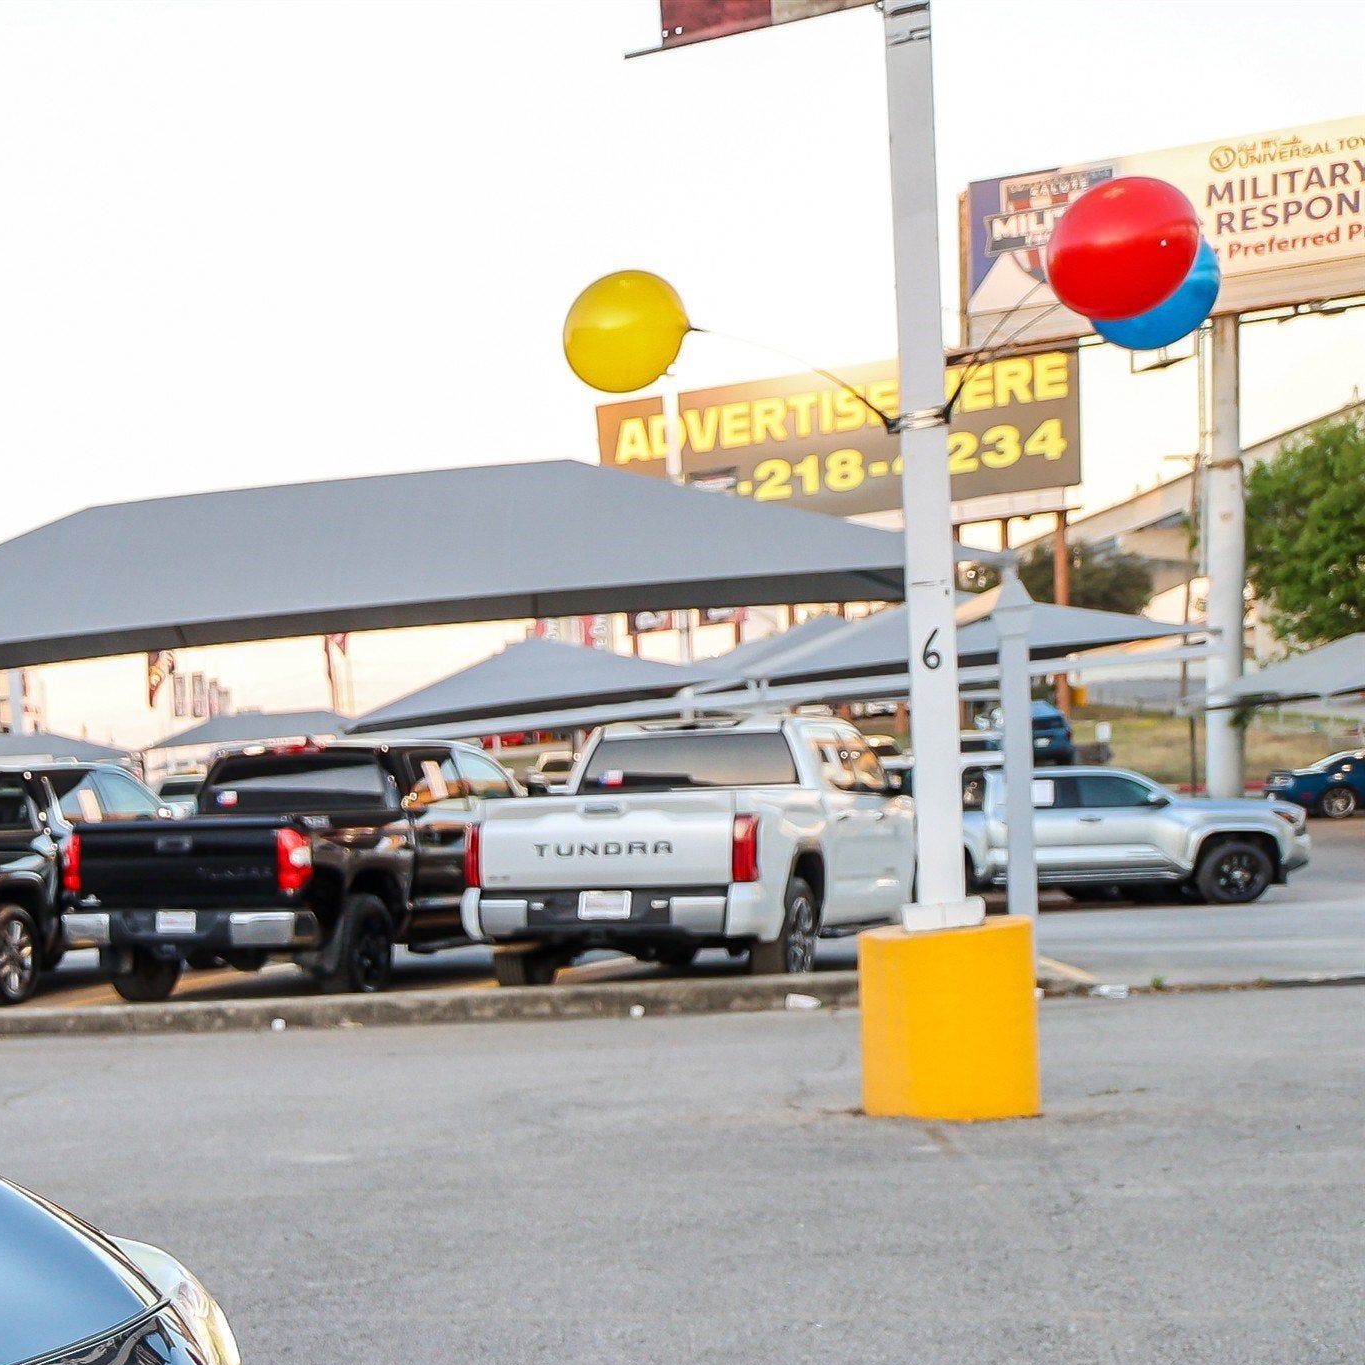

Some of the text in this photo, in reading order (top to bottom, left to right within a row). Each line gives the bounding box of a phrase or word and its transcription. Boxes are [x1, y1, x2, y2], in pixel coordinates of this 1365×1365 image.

[1238, 142, 1334, 167] UNIVERSAL
[1229, 226, 1340, 258] Preferred
[922, 628, 940, 670] 6
[534, 840, 673, 857] TUNDRA
